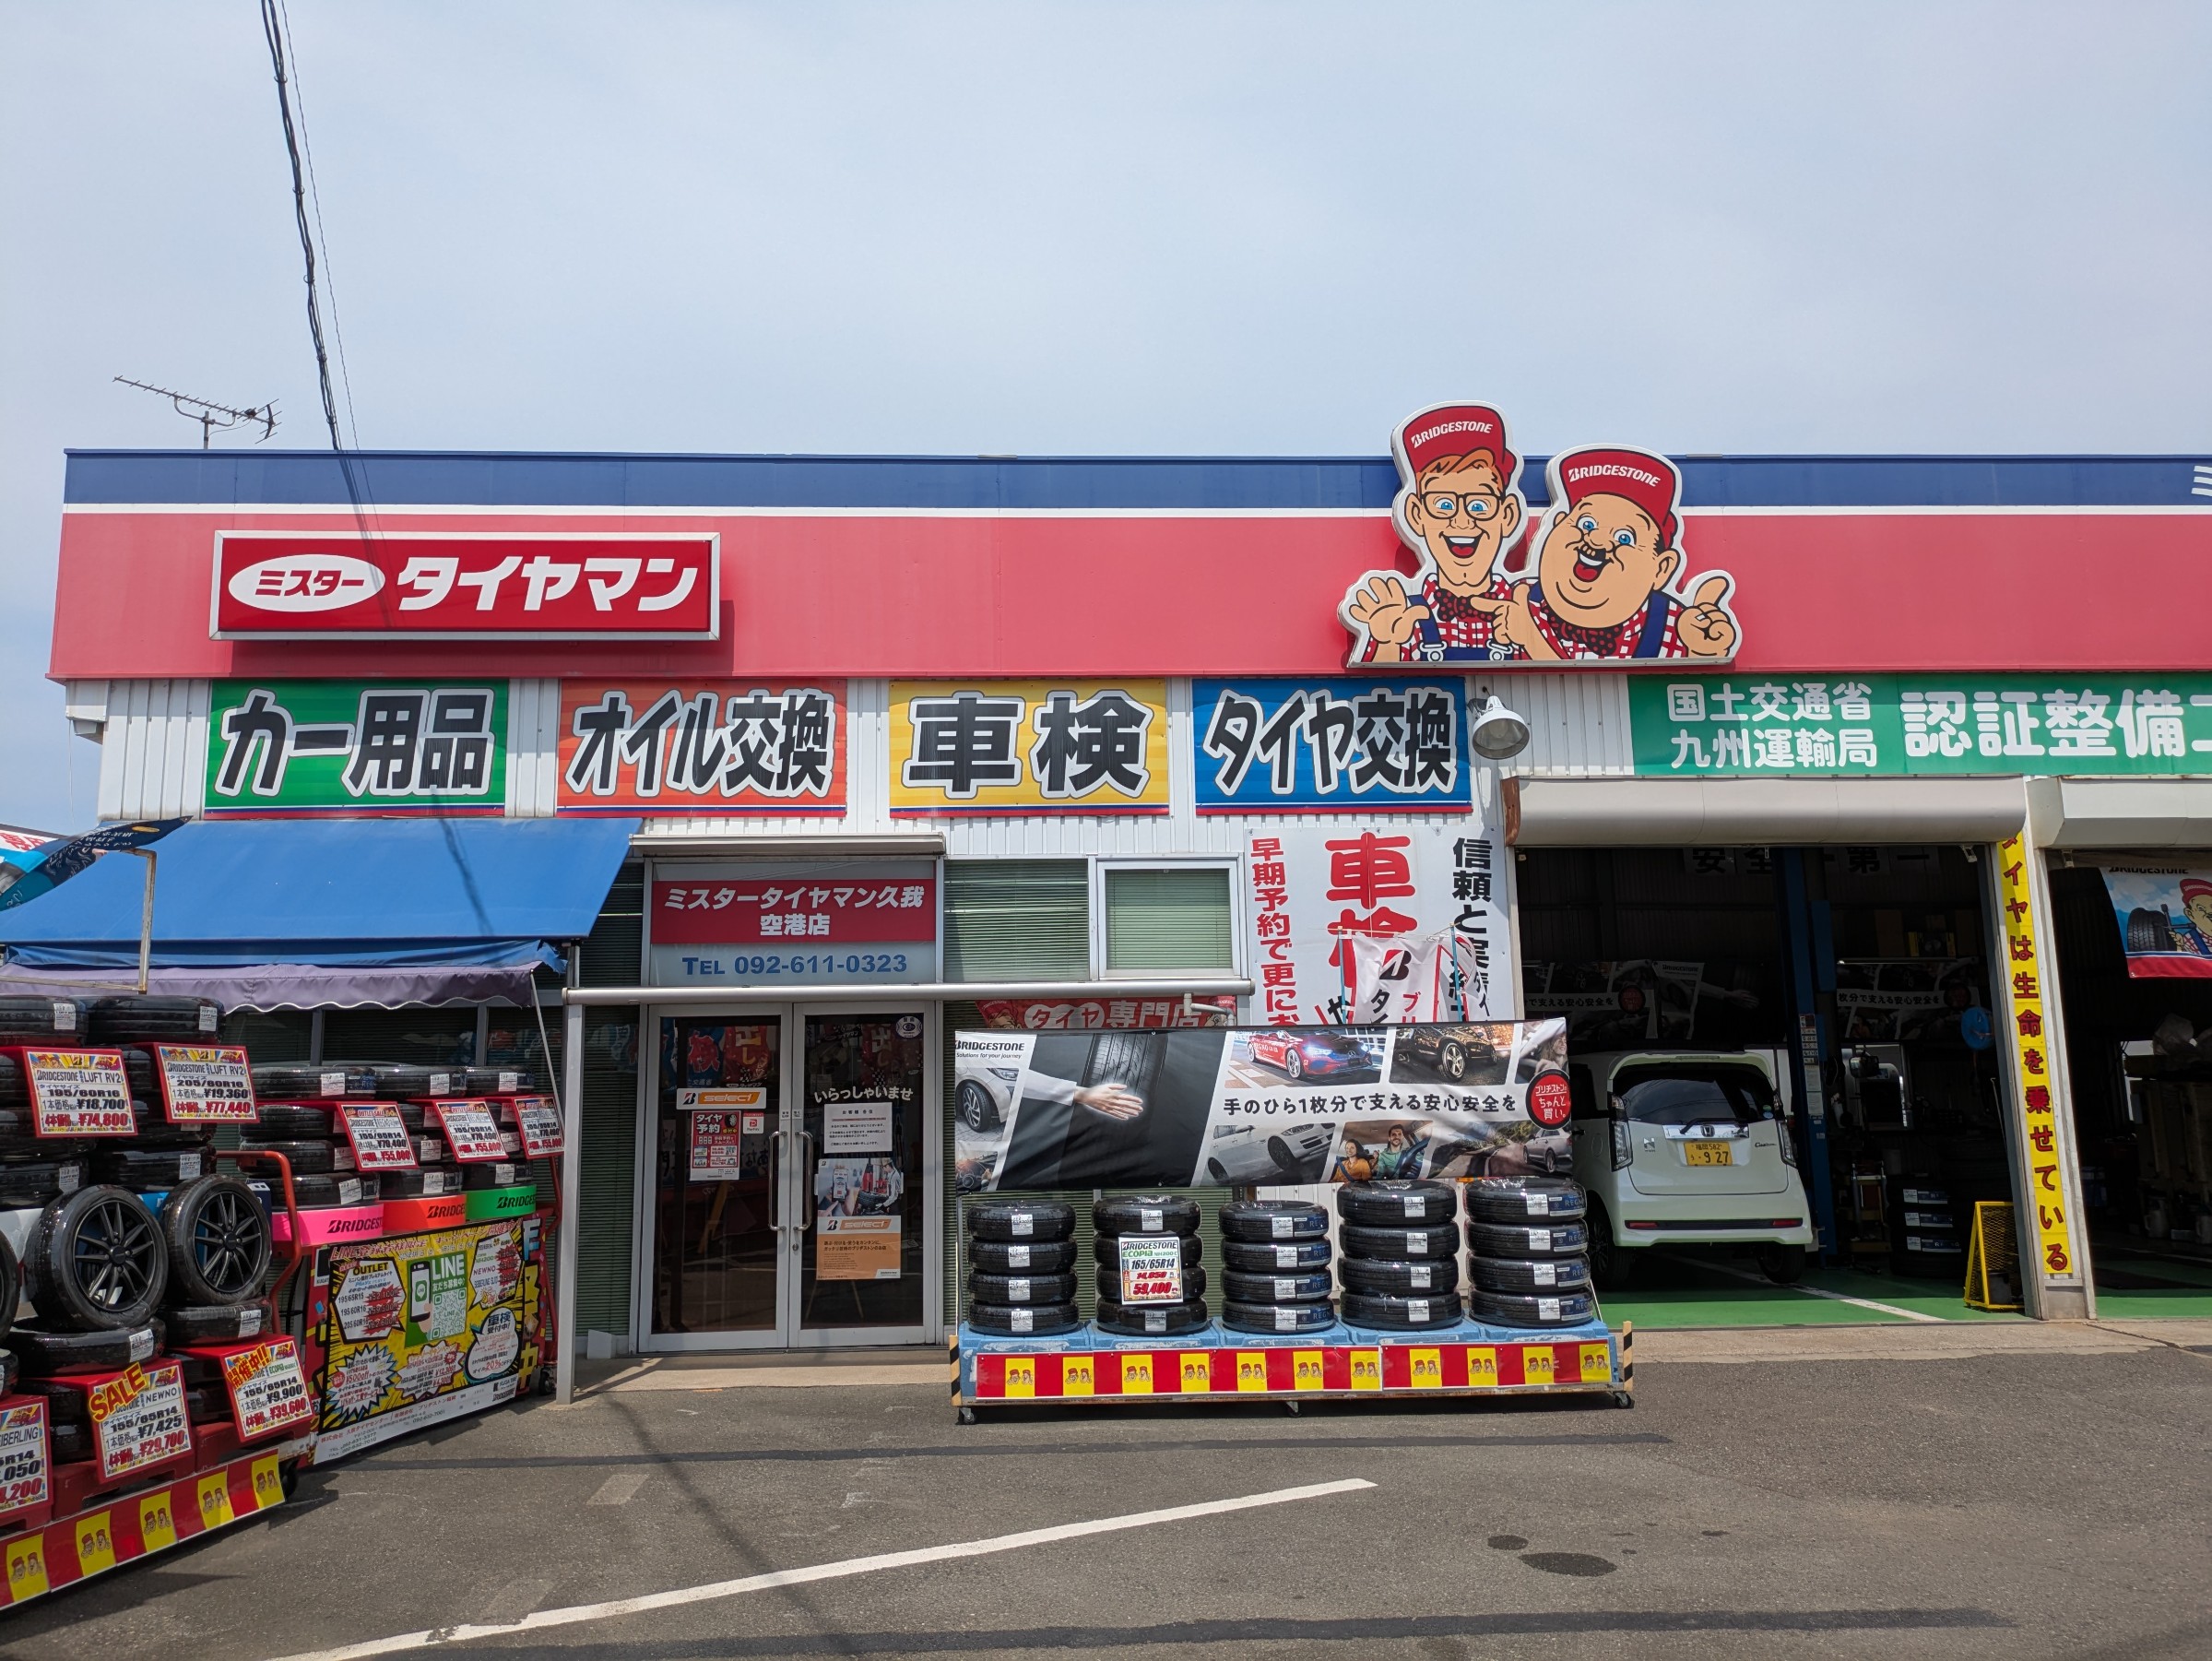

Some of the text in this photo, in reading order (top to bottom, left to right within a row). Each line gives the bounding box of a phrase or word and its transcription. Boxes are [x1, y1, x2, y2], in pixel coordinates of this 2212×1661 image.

[1411, 421, 1493, 448] BRIDGESTONE
[1568, 465, 1661, 487] BRIDGESTONE
[255, 557, 699, 611] ミスター タイヤマン
[1667, 682, 1873, 723] 国土交通省
[215, 689, 495, 798] カー用品
[565, 688, 835, 799] オイル交換
[903, 690, 1153, 800] 車検
[1204, 687, 1459, 795] タイヤ交換
[1671, 729, 1877, 768] 九州運輸局
[665, 885, 925, 909] ミスタータイヤマン久我
[760, 914, 830, 936] 空港店
[735, 954, 907, 976] 092-611-0323
[1032, 1001, 1201, 1027] タイヤ専門店
[955, 1040, 1024, 1050] BRIDGESTONE
[38, 1070, 122, 1083] BRIDGESTONE LUFT RV2
[167, 1062, 244, 1075] BRIDGESTONE LUFT RV2
[47, 1089, 120, 1097] 195/60R16
[204, 1088, 248, 1099] ¥19,360
[704, 1094, 753, 1102] select
[814, 1086, 913, 1103] いらっしゃいませ
[1224, 1092, 1516, 1116] 手のひら1枚分で支える安心安全を
[1539, 1096, 1566, 1108] ちゃんと
[77, 1098, 125, 1111] ¥18,700
[206, 1101, 251, 1114] ¥77,440
[78, 1112, 128, 1127] ¥74,800
[696, 1114, 723, 1122] タイヤ
[696, 1124, 720, 1133] 予約
[1122, 1241, 1177, 1251] BRIDGESTONE
[353, 1263, 388, 1275] OUTLET
[432, 1254, 465, 1280] LINE
[1131, 1258, 1176, 1270] 165/65R14
[1132, 1282, 1172, 1295] 59,400
[488, 1311, 511, 1326] 車検
[227, 1343, 270, 1390] 開催中!!
[89, 1363, 146, 1420] SALE
[147, 1387, 177, 1403] NEWNO
[266, 1384, 302, 1404] ¥9,900
[112, 1406, 178, 1432] 155/65R14
[270, 1397, 306, 1420] ¥39,600
[138, 1415, 182, 1439] ¥7,425
[139, 1430, 185, 1458] ¥29,700
